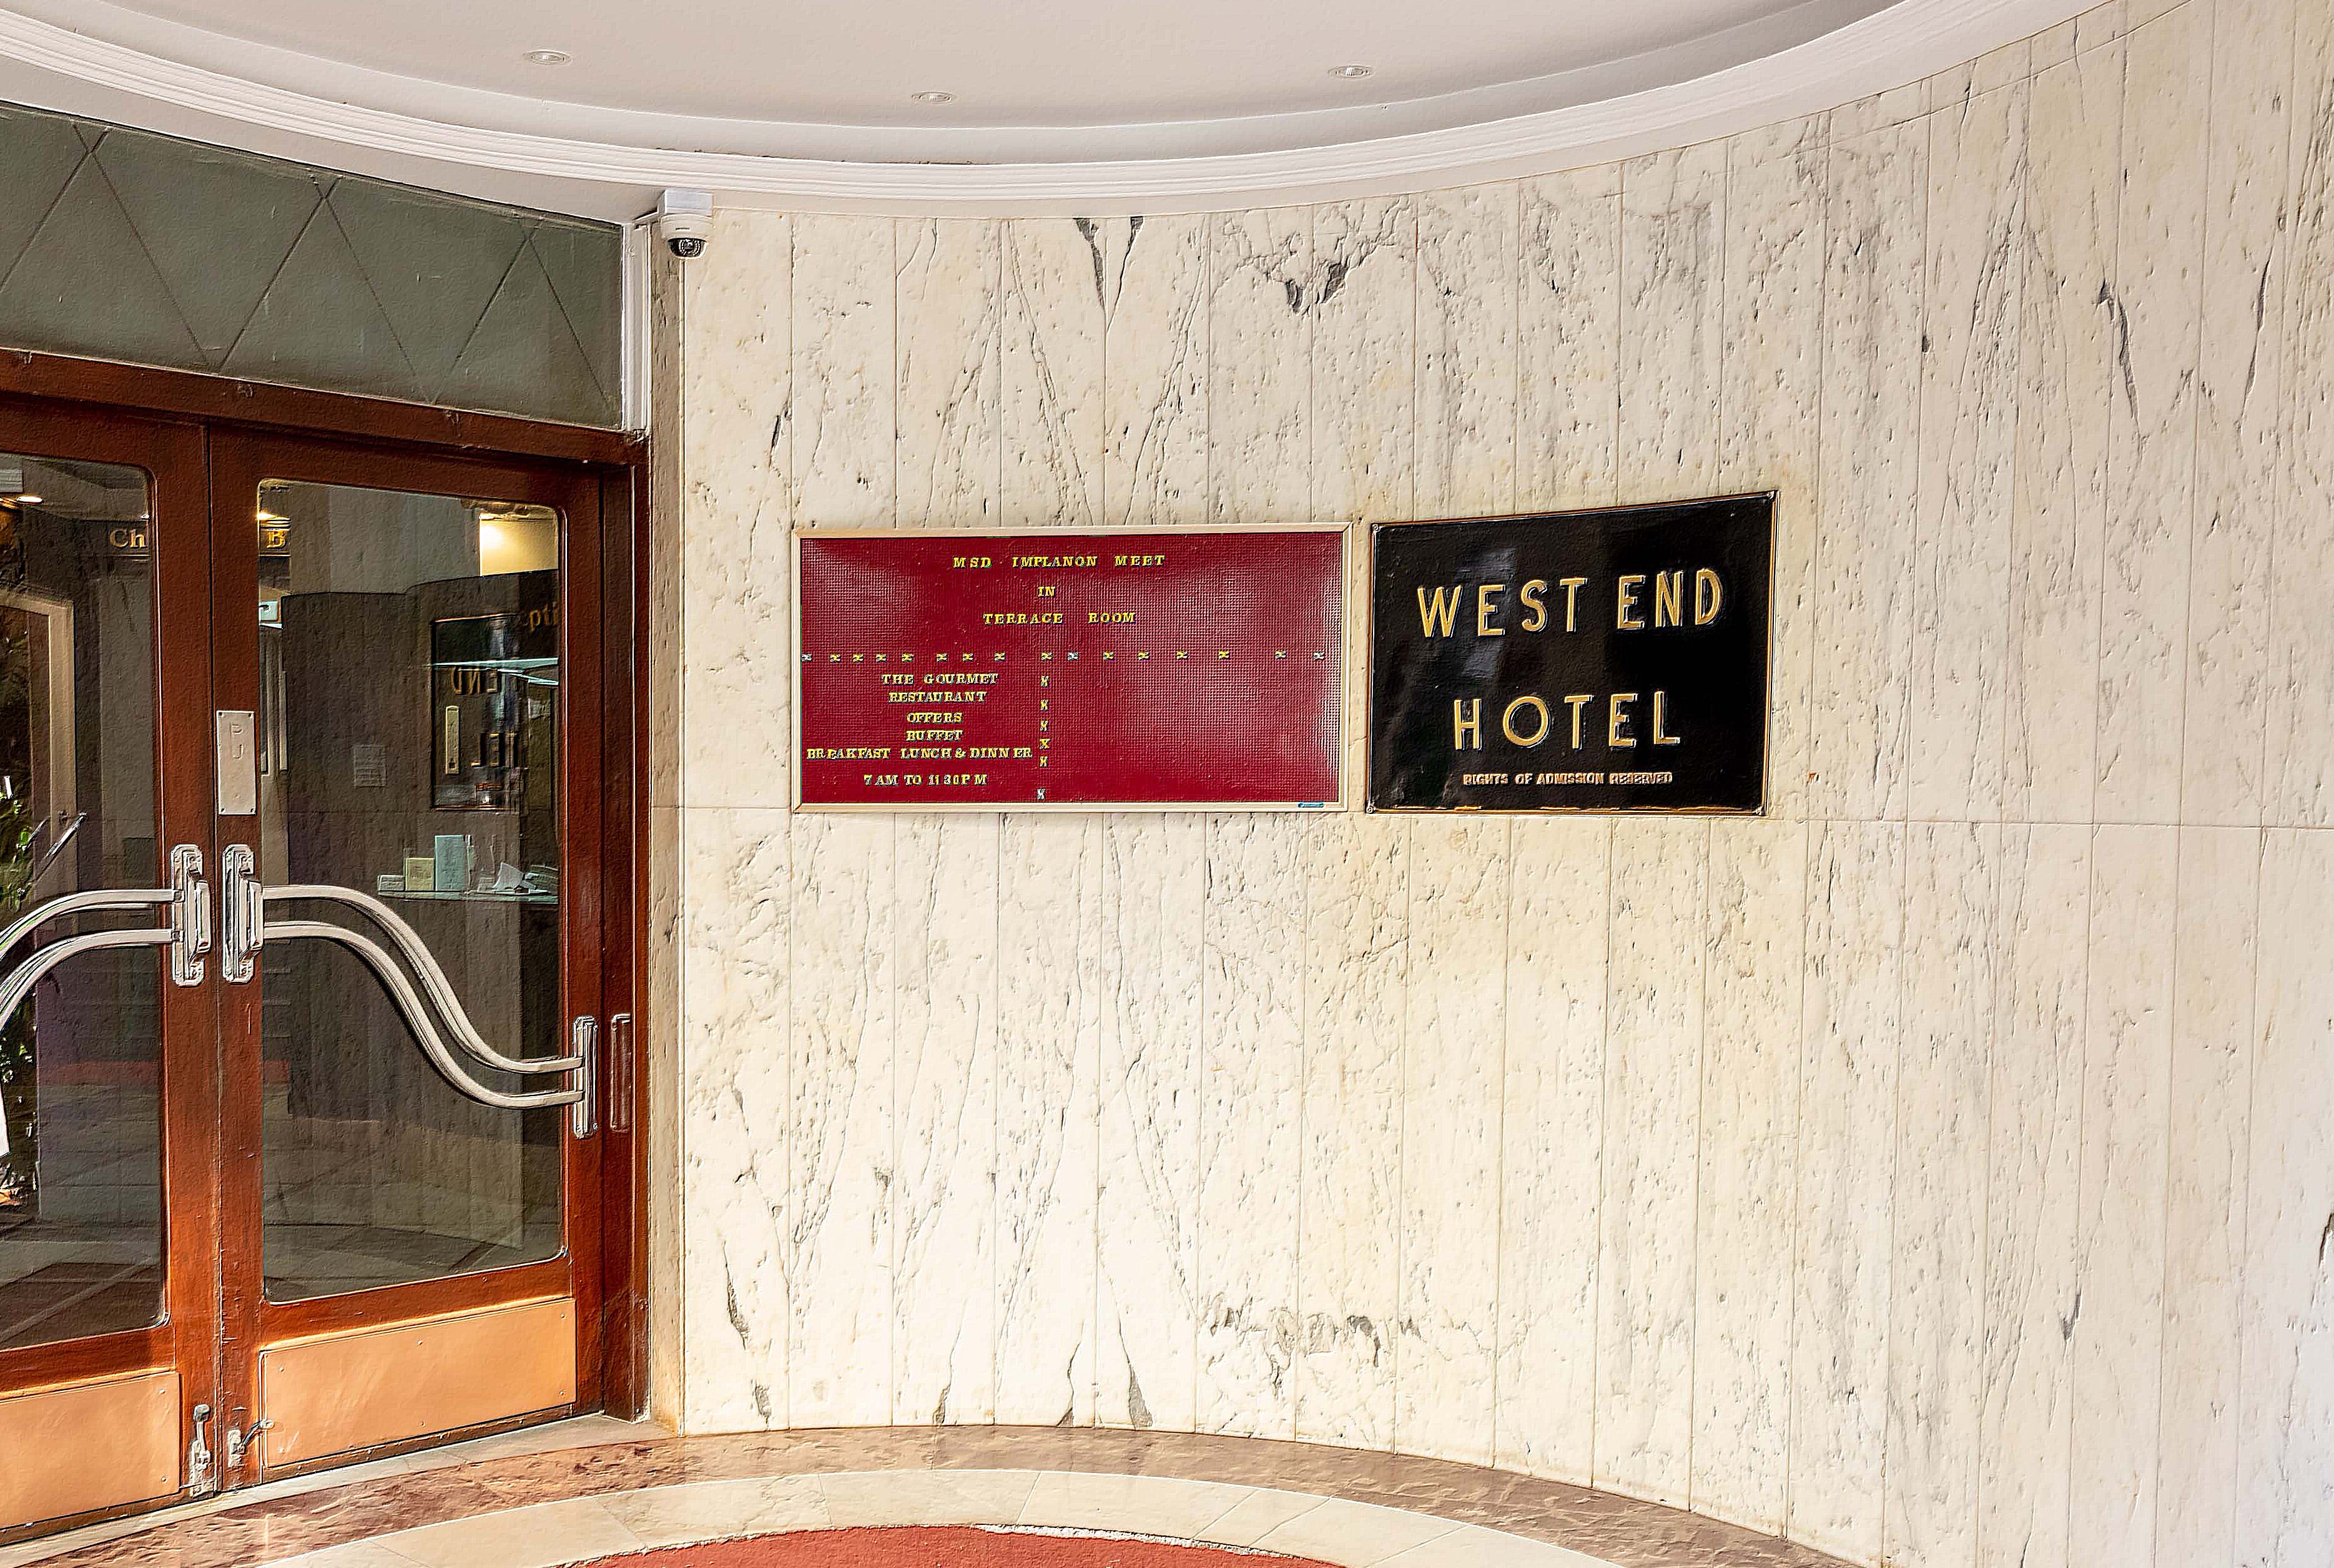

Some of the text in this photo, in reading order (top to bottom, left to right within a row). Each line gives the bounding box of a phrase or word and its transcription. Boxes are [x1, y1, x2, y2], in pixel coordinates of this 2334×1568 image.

[953, 556, 1165, 567] MSD IMPLANON MEET
[1038, 587, 1055, 597] IN
[1417, 568, 1721, 637] WEST END
[983, 612, 1135, 624] TERRACE ROOM
[882, 674, 998, 684] THE GOURMET
[889, 692, 987, 702] RESTAURANT
[907, 712, 962, 723] OFFERS
[1454, 691, 1680, 750] HOTEL
[907, 730, 962, 740] BUFFET
[807, 747, 890, 759] BREAKFAST
[904, 775, 921, 785] TO
[1464, 772, 1672, 785] RIGHTS OF ADMISSION RESERVED
